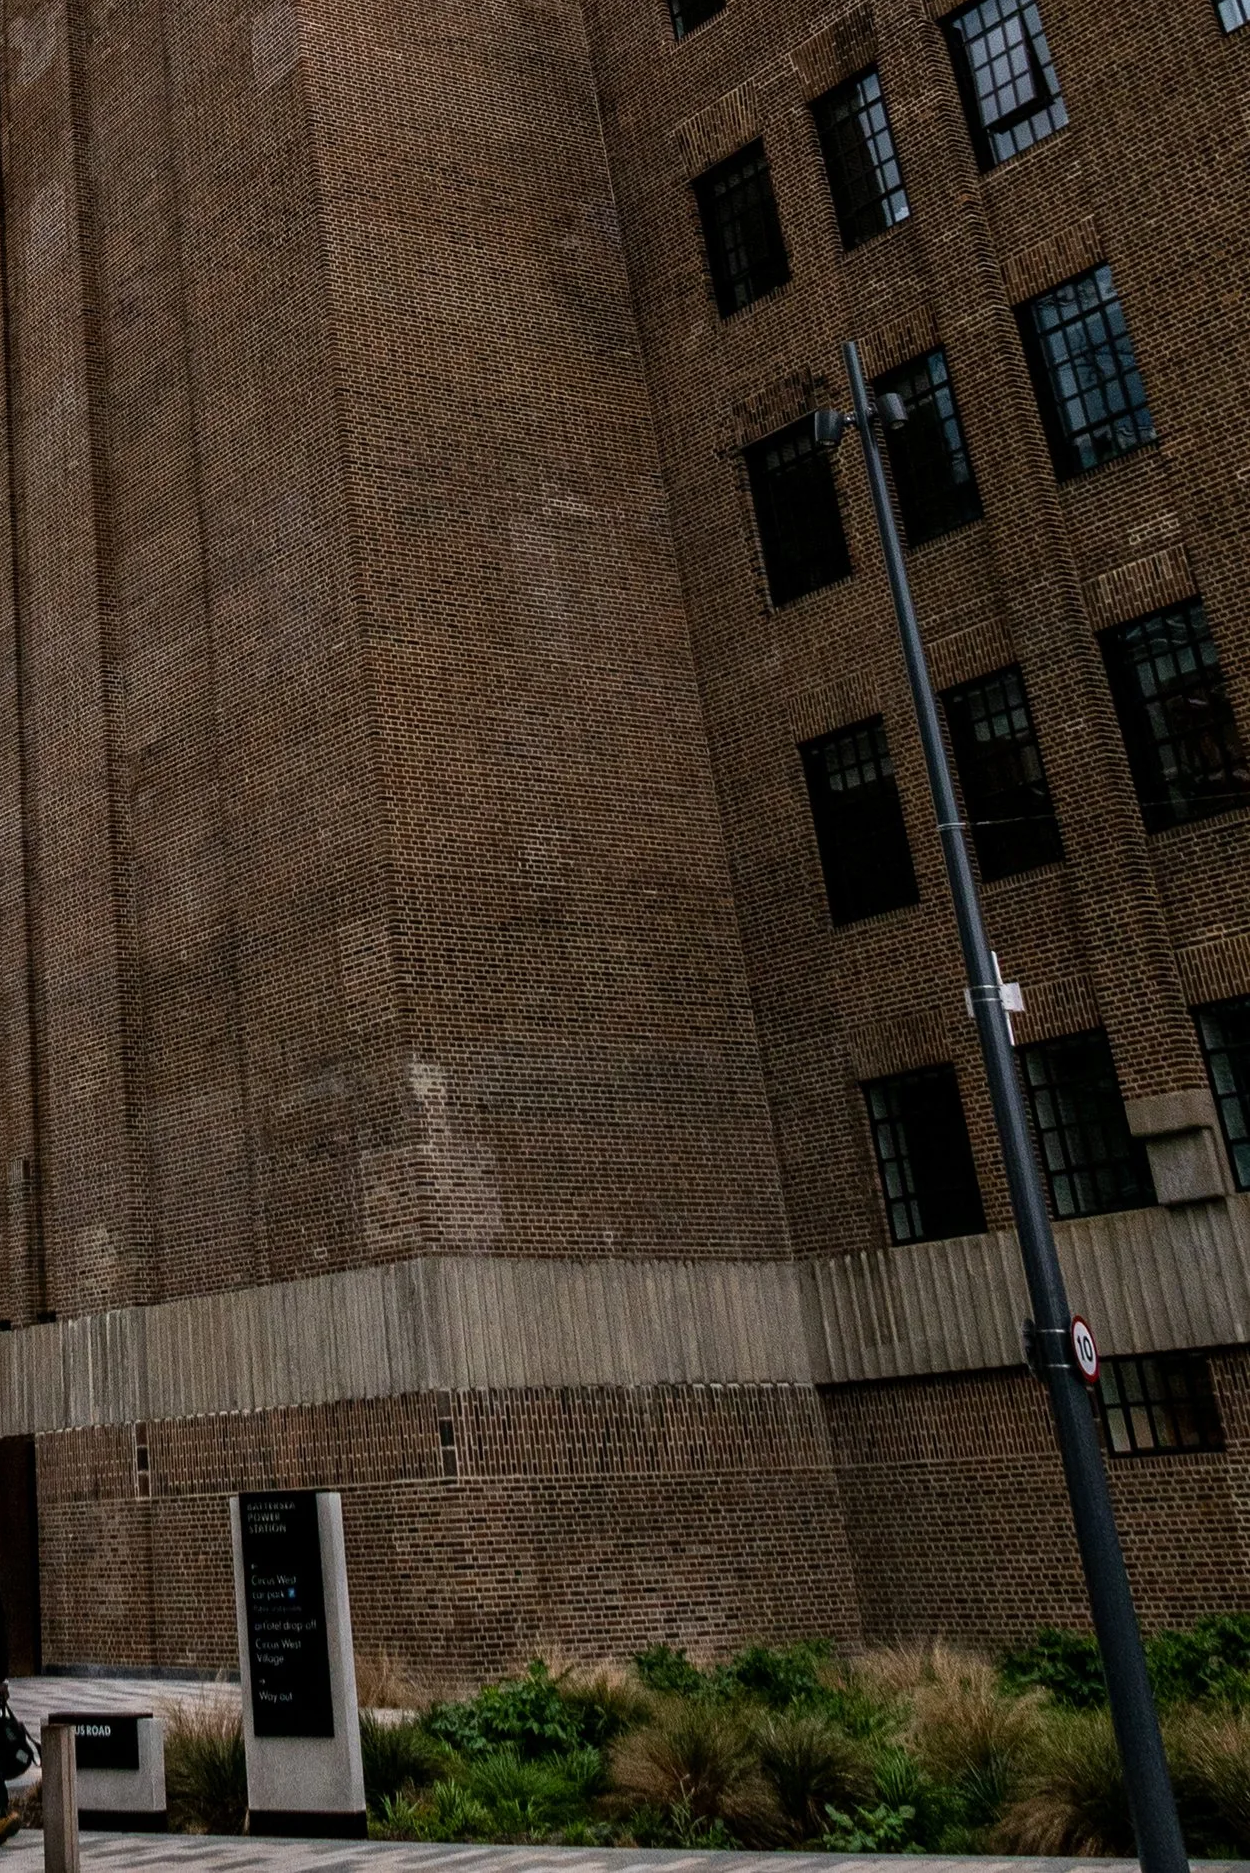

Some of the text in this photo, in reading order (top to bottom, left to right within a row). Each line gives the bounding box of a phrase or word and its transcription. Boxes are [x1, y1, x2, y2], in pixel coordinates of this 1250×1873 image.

[1077, 1336, 1093, 1361] 10
[247, 1511, 281, 1523] POWER
[248, 1522, 287, 1534] STATION
[251, 1574, 297, 1586] Circus West
[267, 1589, 285, 1602] park
[255, 1638, 302, 1650] Circus West
[256, 1653, 284, 1667] Village
[258, 1689, 293, 1704] Way out
[86, 1724, 111, 1737] ROAD
